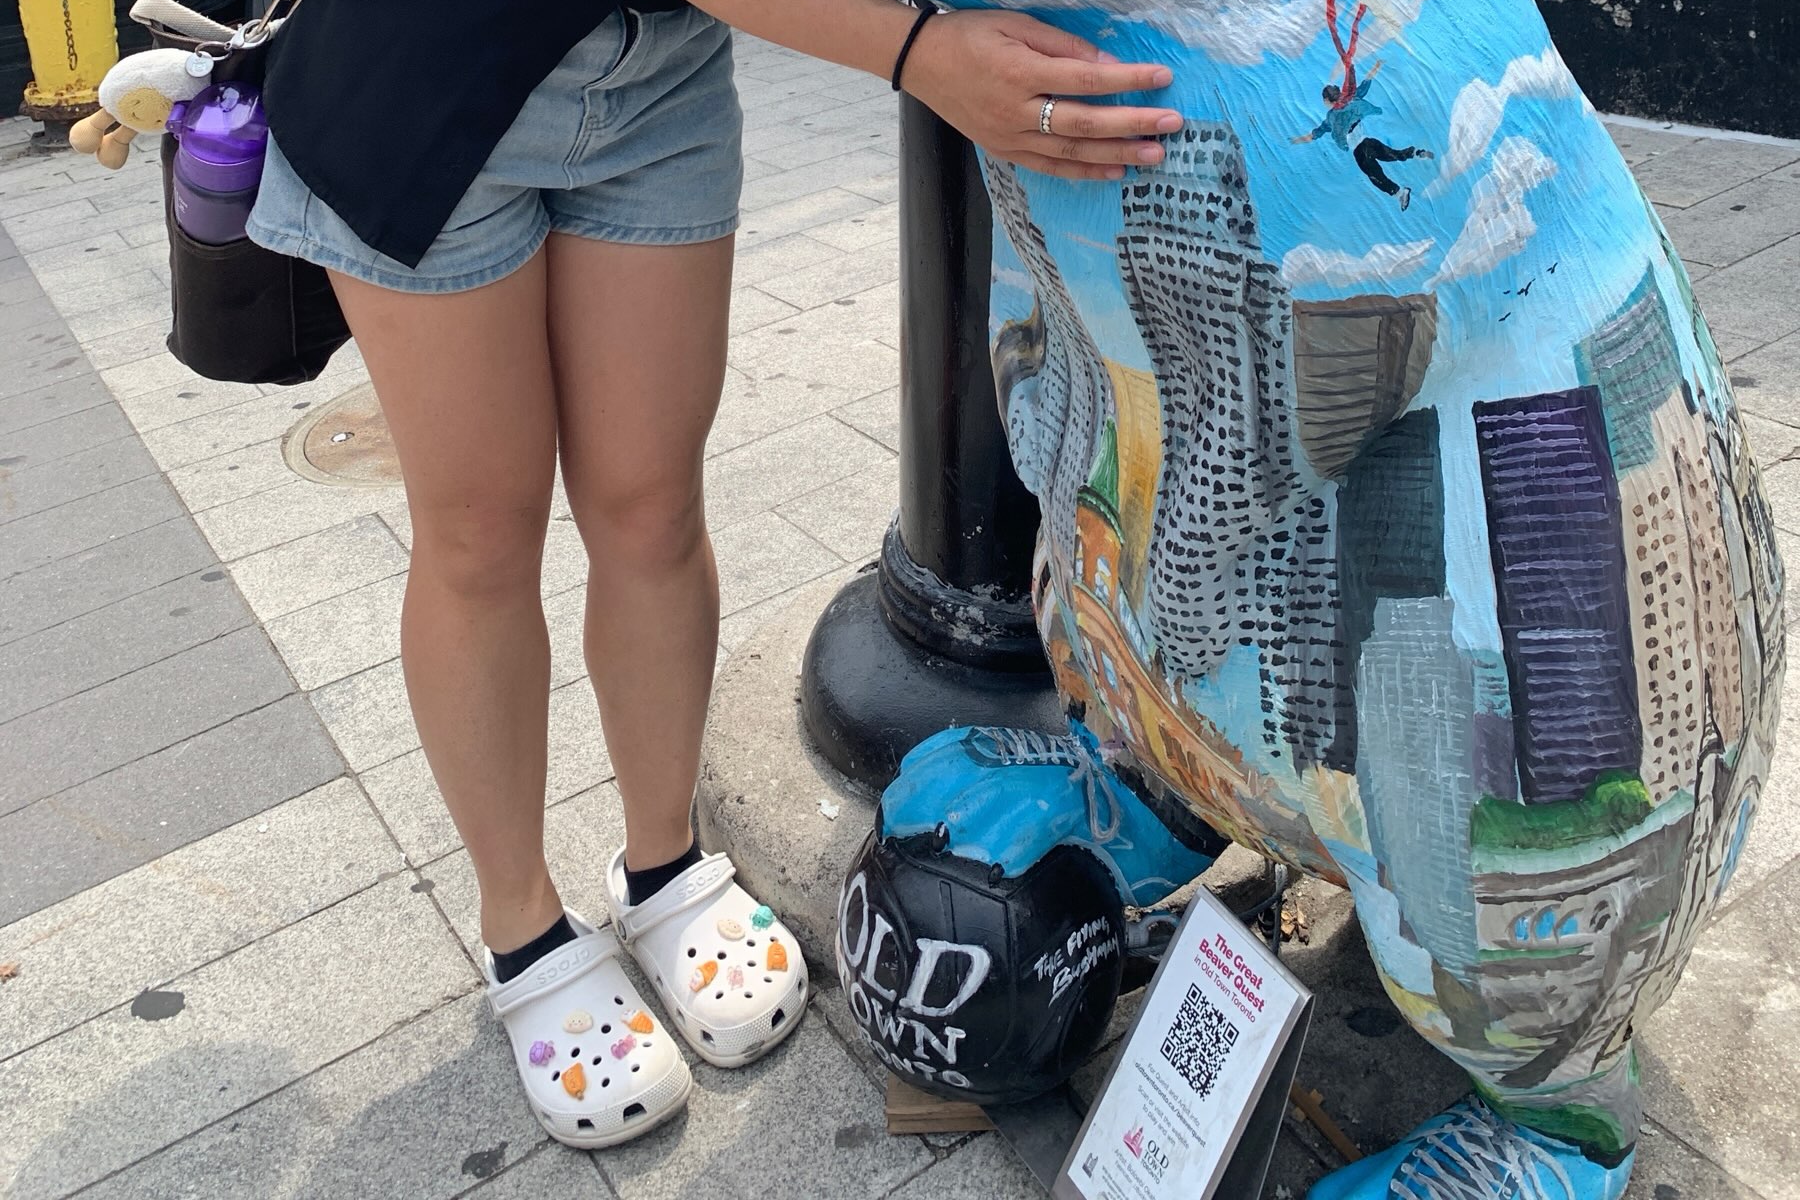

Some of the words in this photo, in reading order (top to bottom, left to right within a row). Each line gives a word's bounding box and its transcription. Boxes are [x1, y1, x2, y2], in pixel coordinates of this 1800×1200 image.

[841, 871, 990, 1017] OLD
[1034, 949, 1064, 981] THE
[1198, 938, 1234, 979] Beaver
[1234, 976, 1265, 1012] Quest
[1215, 933, 1233, 960] The
[1234, 956, 1263, 989] Great
[1194, 954, 1200, 965] in
[1201, 963, 1213, 978] Old
[1214, 974, 1229, 997] Town
[1232, 992, 1255, 1022] Toronto
[851, 982, 966, 1065] OWN
[1144, 1149, 1164, 1178] TOWN
[1148, 1141, 1169, 1169] OLD
